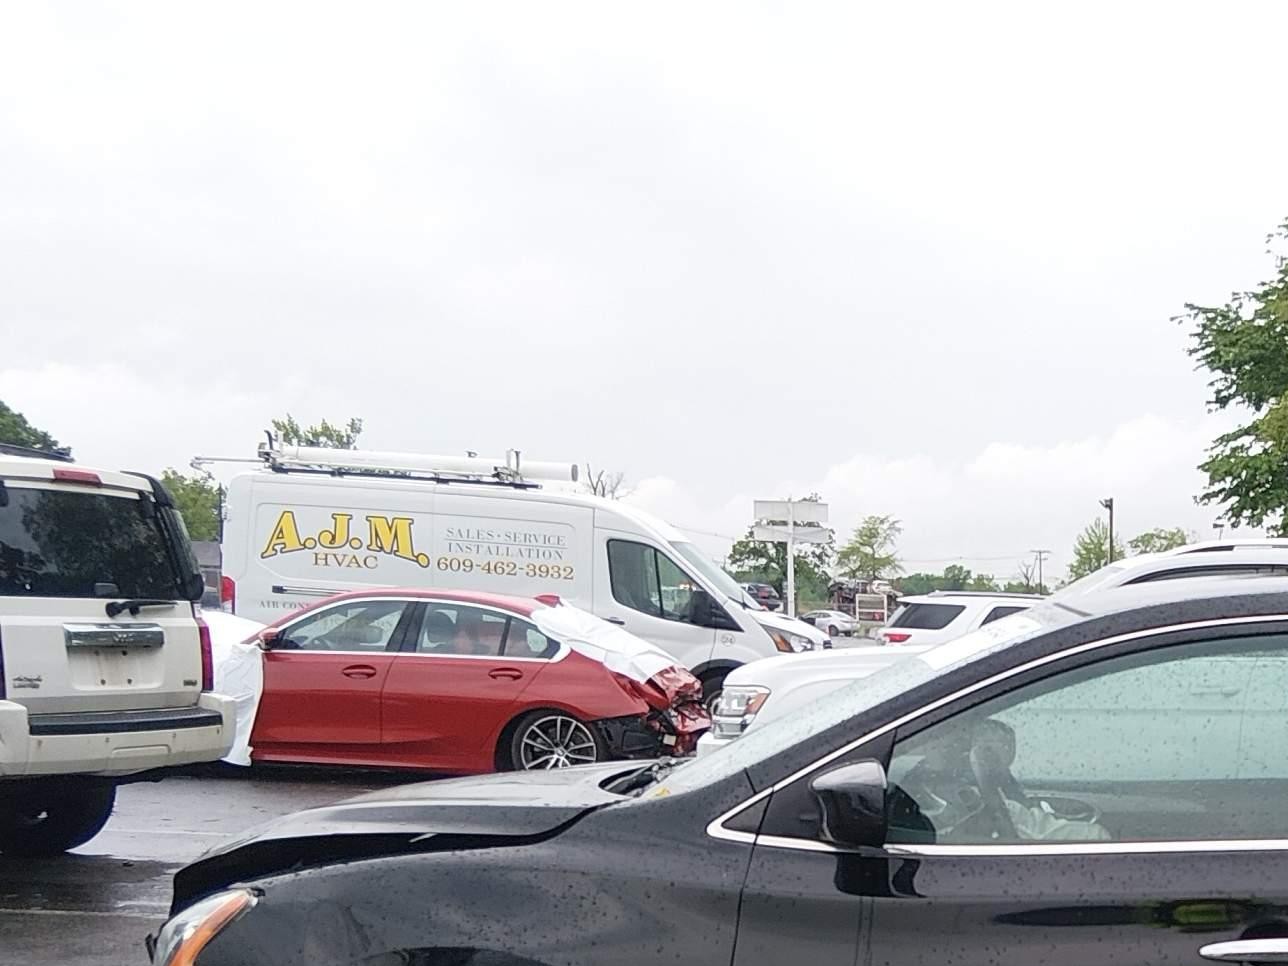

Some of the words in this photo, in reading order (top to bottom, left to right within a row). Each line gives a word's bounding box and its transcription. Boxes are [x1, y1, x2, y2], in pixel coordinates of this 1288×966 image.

[261, 511, 430, 568] A.J.M.
[446, 527, 495, 539] SALES
[504, 531, 566, 546] SERVICE
[448, 542, 564, 560] INSTALLATION
[312, 552, 379, 569] HVAC
[437, 556, 574, 580] 609-462-3932
[259, 600, 279, 609] AIR
